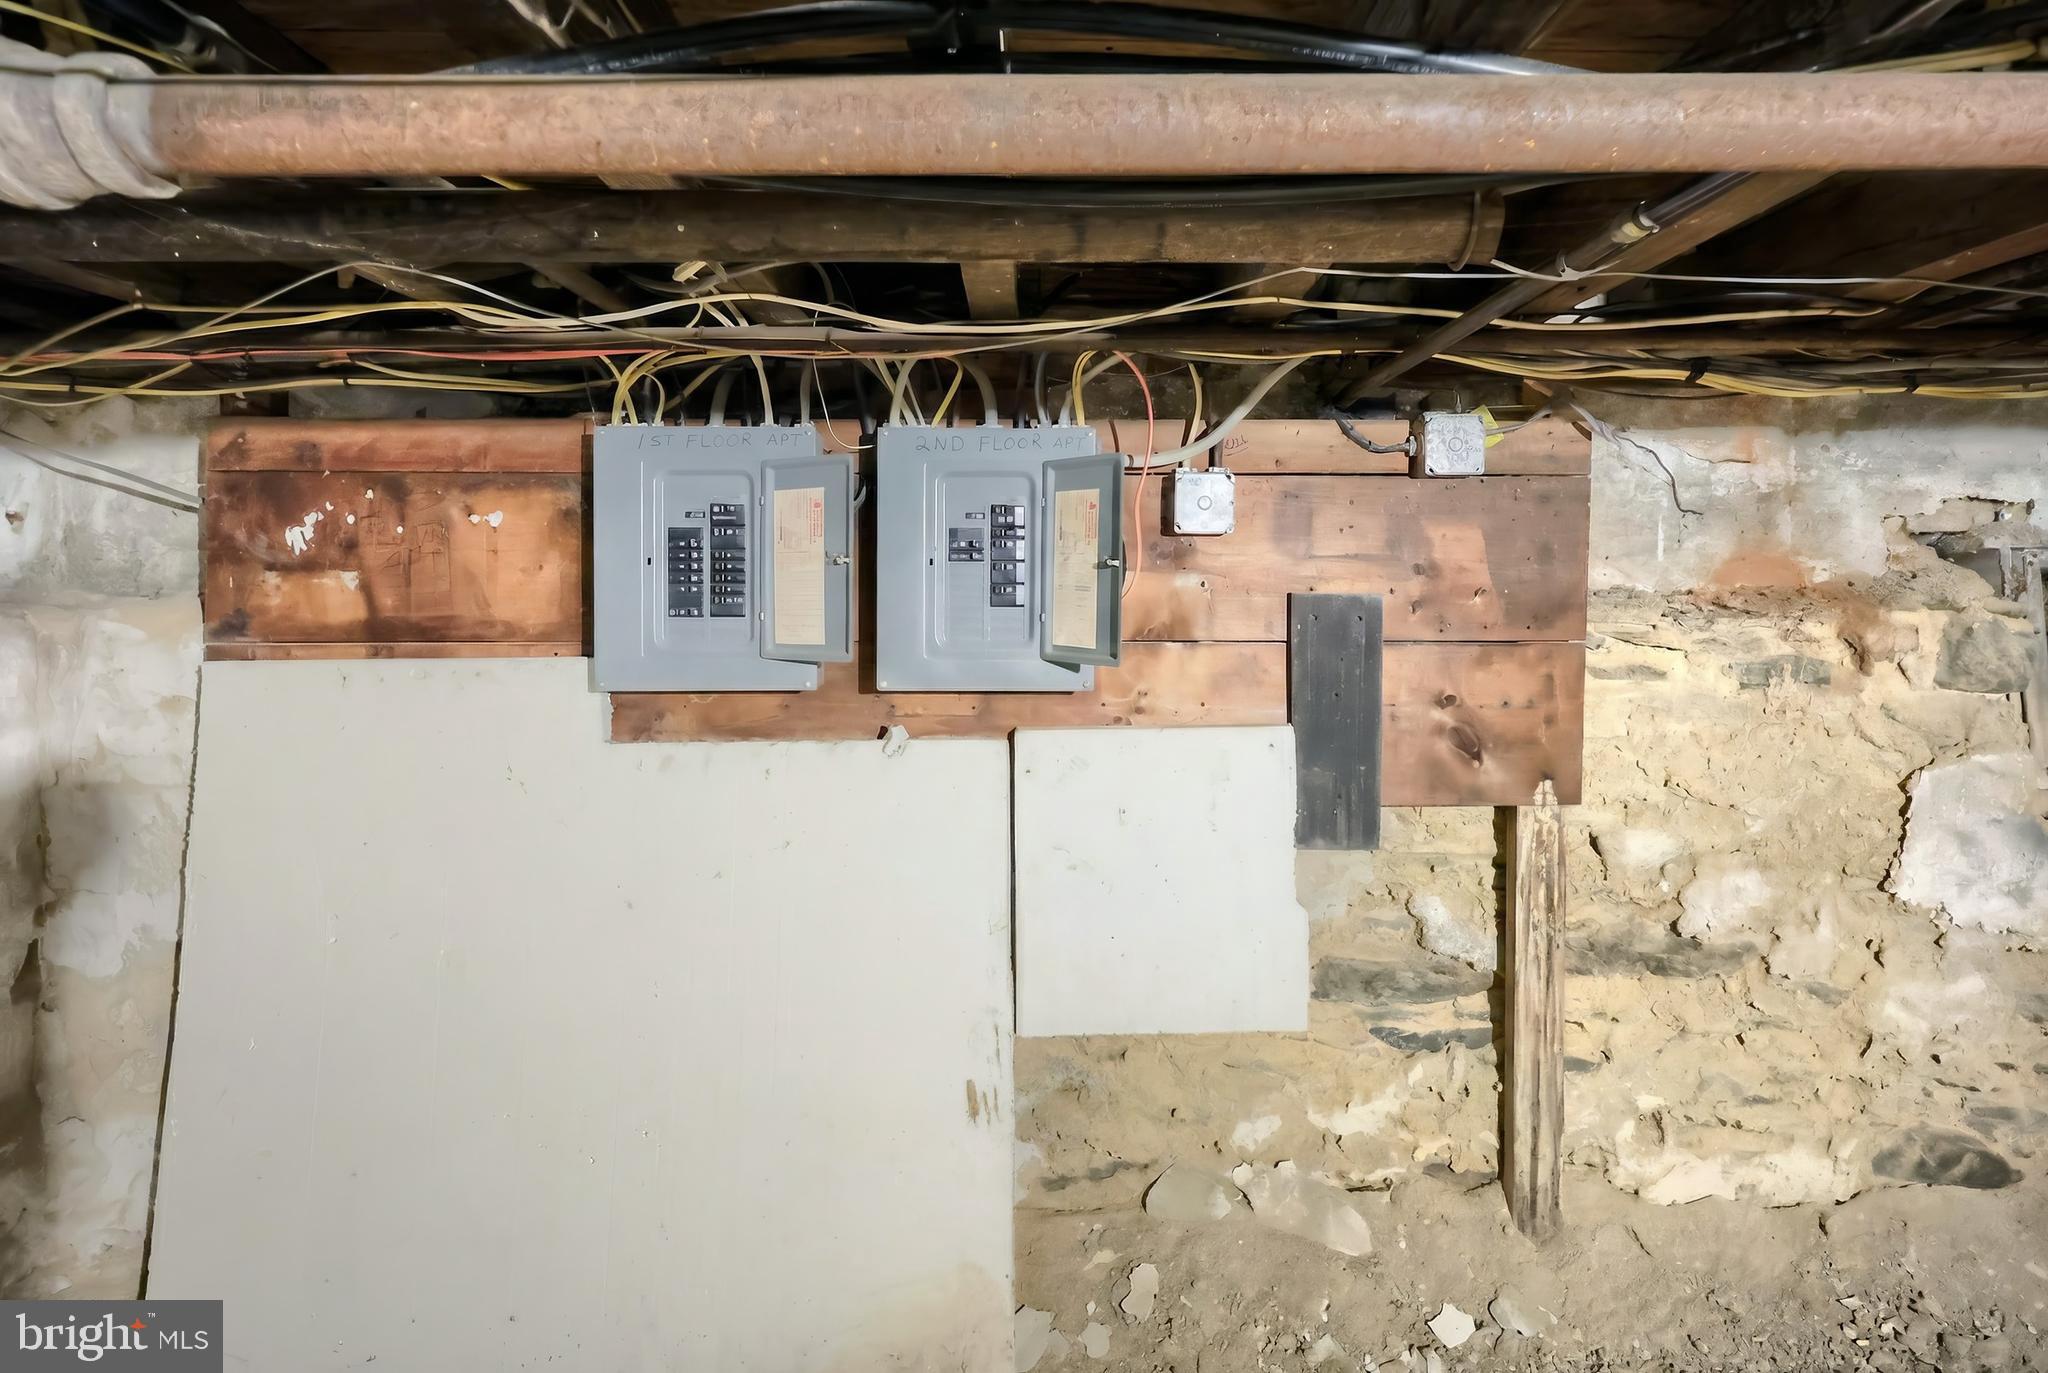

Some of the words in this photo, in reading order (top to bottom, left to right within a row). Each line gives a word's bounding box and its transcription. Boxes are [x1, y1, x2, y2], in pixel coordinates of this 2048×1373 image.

[685, 433, 752, 448] FLOOR
[915, 435, 965, 452] 2ND
[979, 432, 1042, 452] FLOOR
